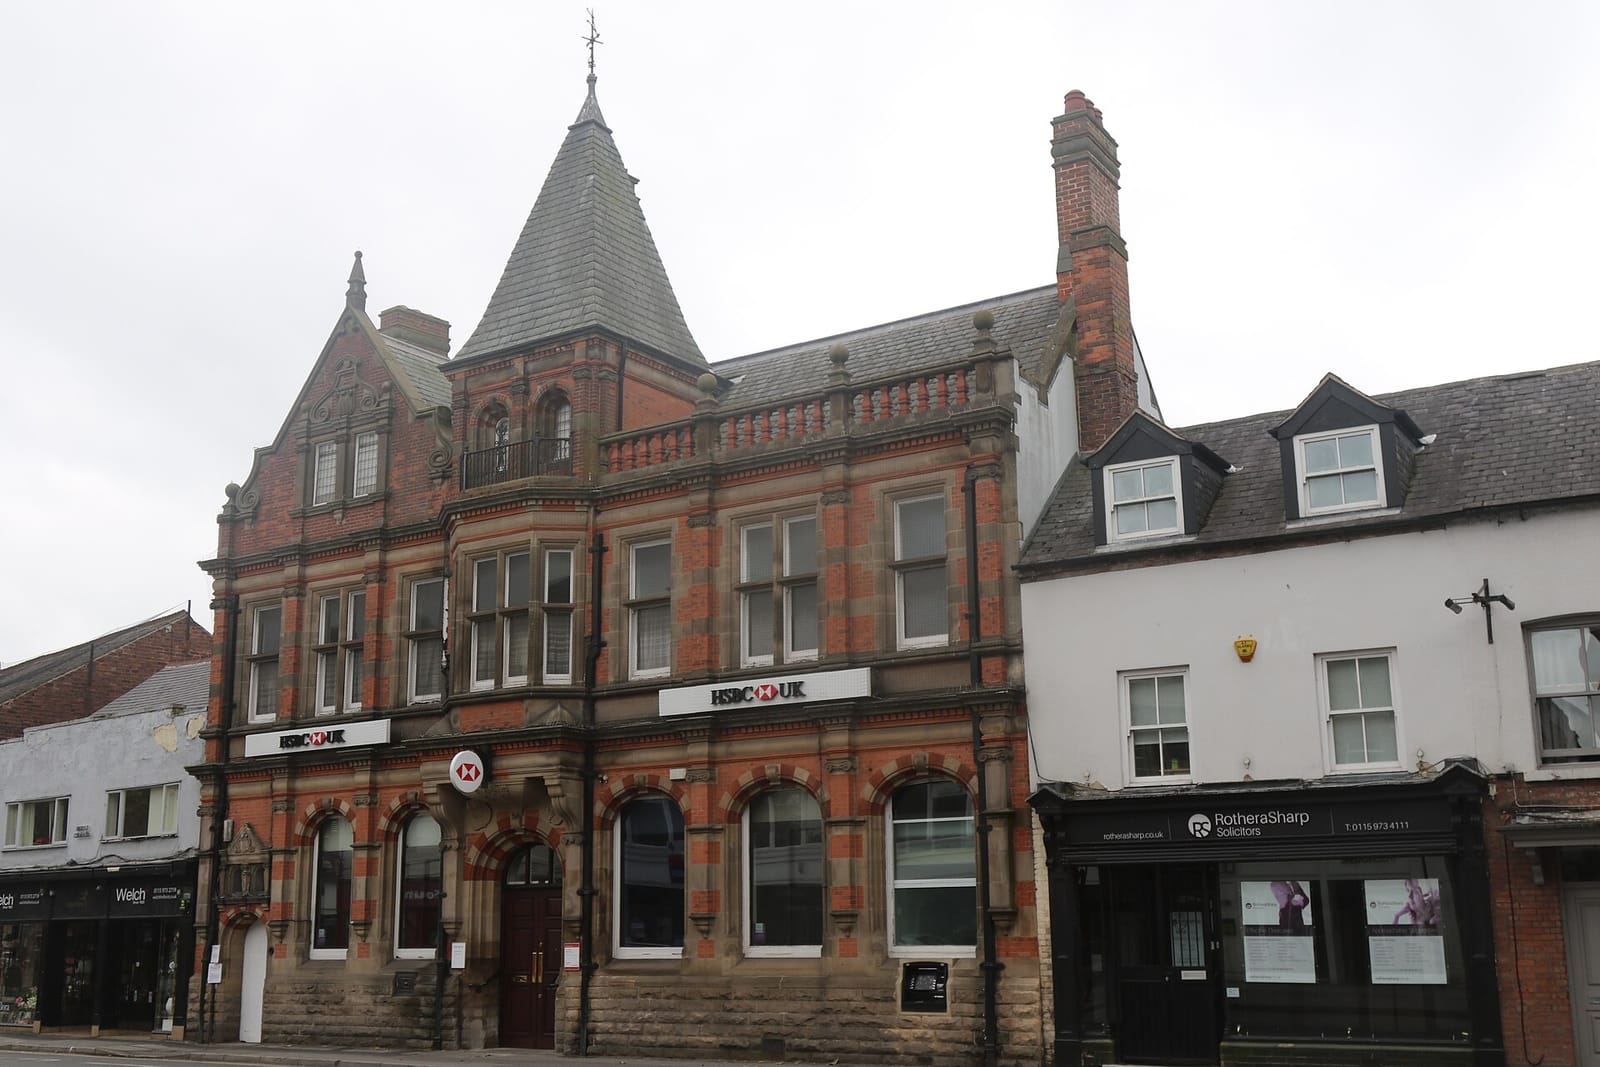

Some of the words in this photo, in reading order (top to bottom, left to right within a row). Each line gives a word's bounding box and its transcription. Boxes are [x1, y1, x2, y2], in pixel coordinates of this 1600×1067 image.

[711, 686, 754, 705] HSBC
[778, 681, 806, 698] UK
[327, 729, 346, 744] UK
[1215, 810, 1310, 826] RotheraSharp
[1103, 831, 1164, 841] rotherasharp.co.uk
[1216, 827, 1261, 837] Solicitors
[116, 888, 146, 902] Welch
